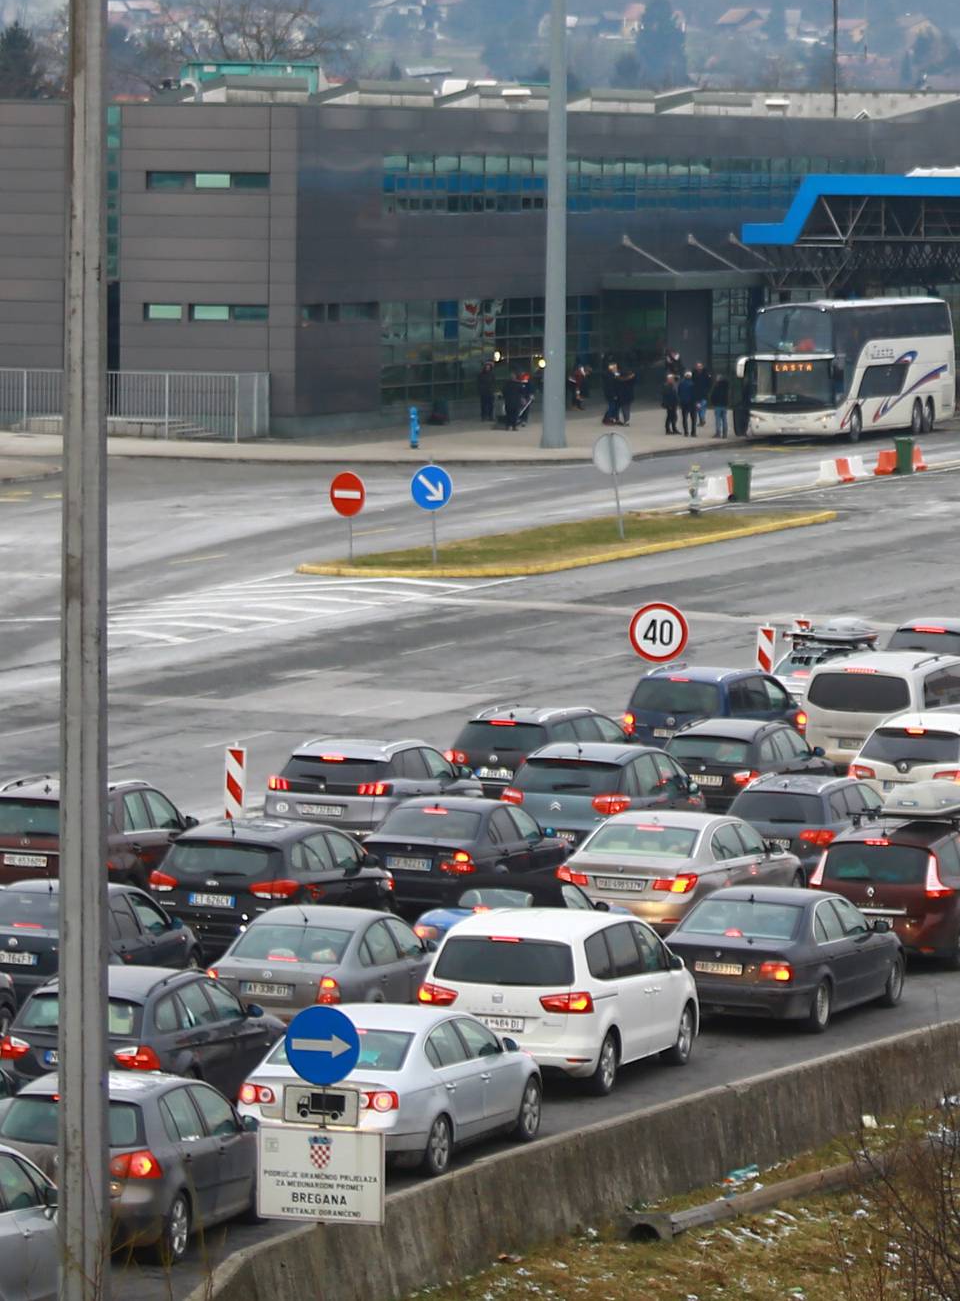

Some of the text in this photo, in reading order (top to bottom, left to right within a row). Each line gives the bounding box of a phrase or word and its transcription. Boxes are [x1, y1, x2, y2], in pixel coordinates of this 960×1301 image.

[775, 363, 812, 372] LASTA
[643, 618, 674, 647] 40
[340, 1174, 378, 1183] PRIJELAZA
[336, 1183, 364, 1191] PROMET
[291, 1192, 348, 1206] BREGANA
[281, 1206, 362, 1218] KRETANJE OGRANIČENO
